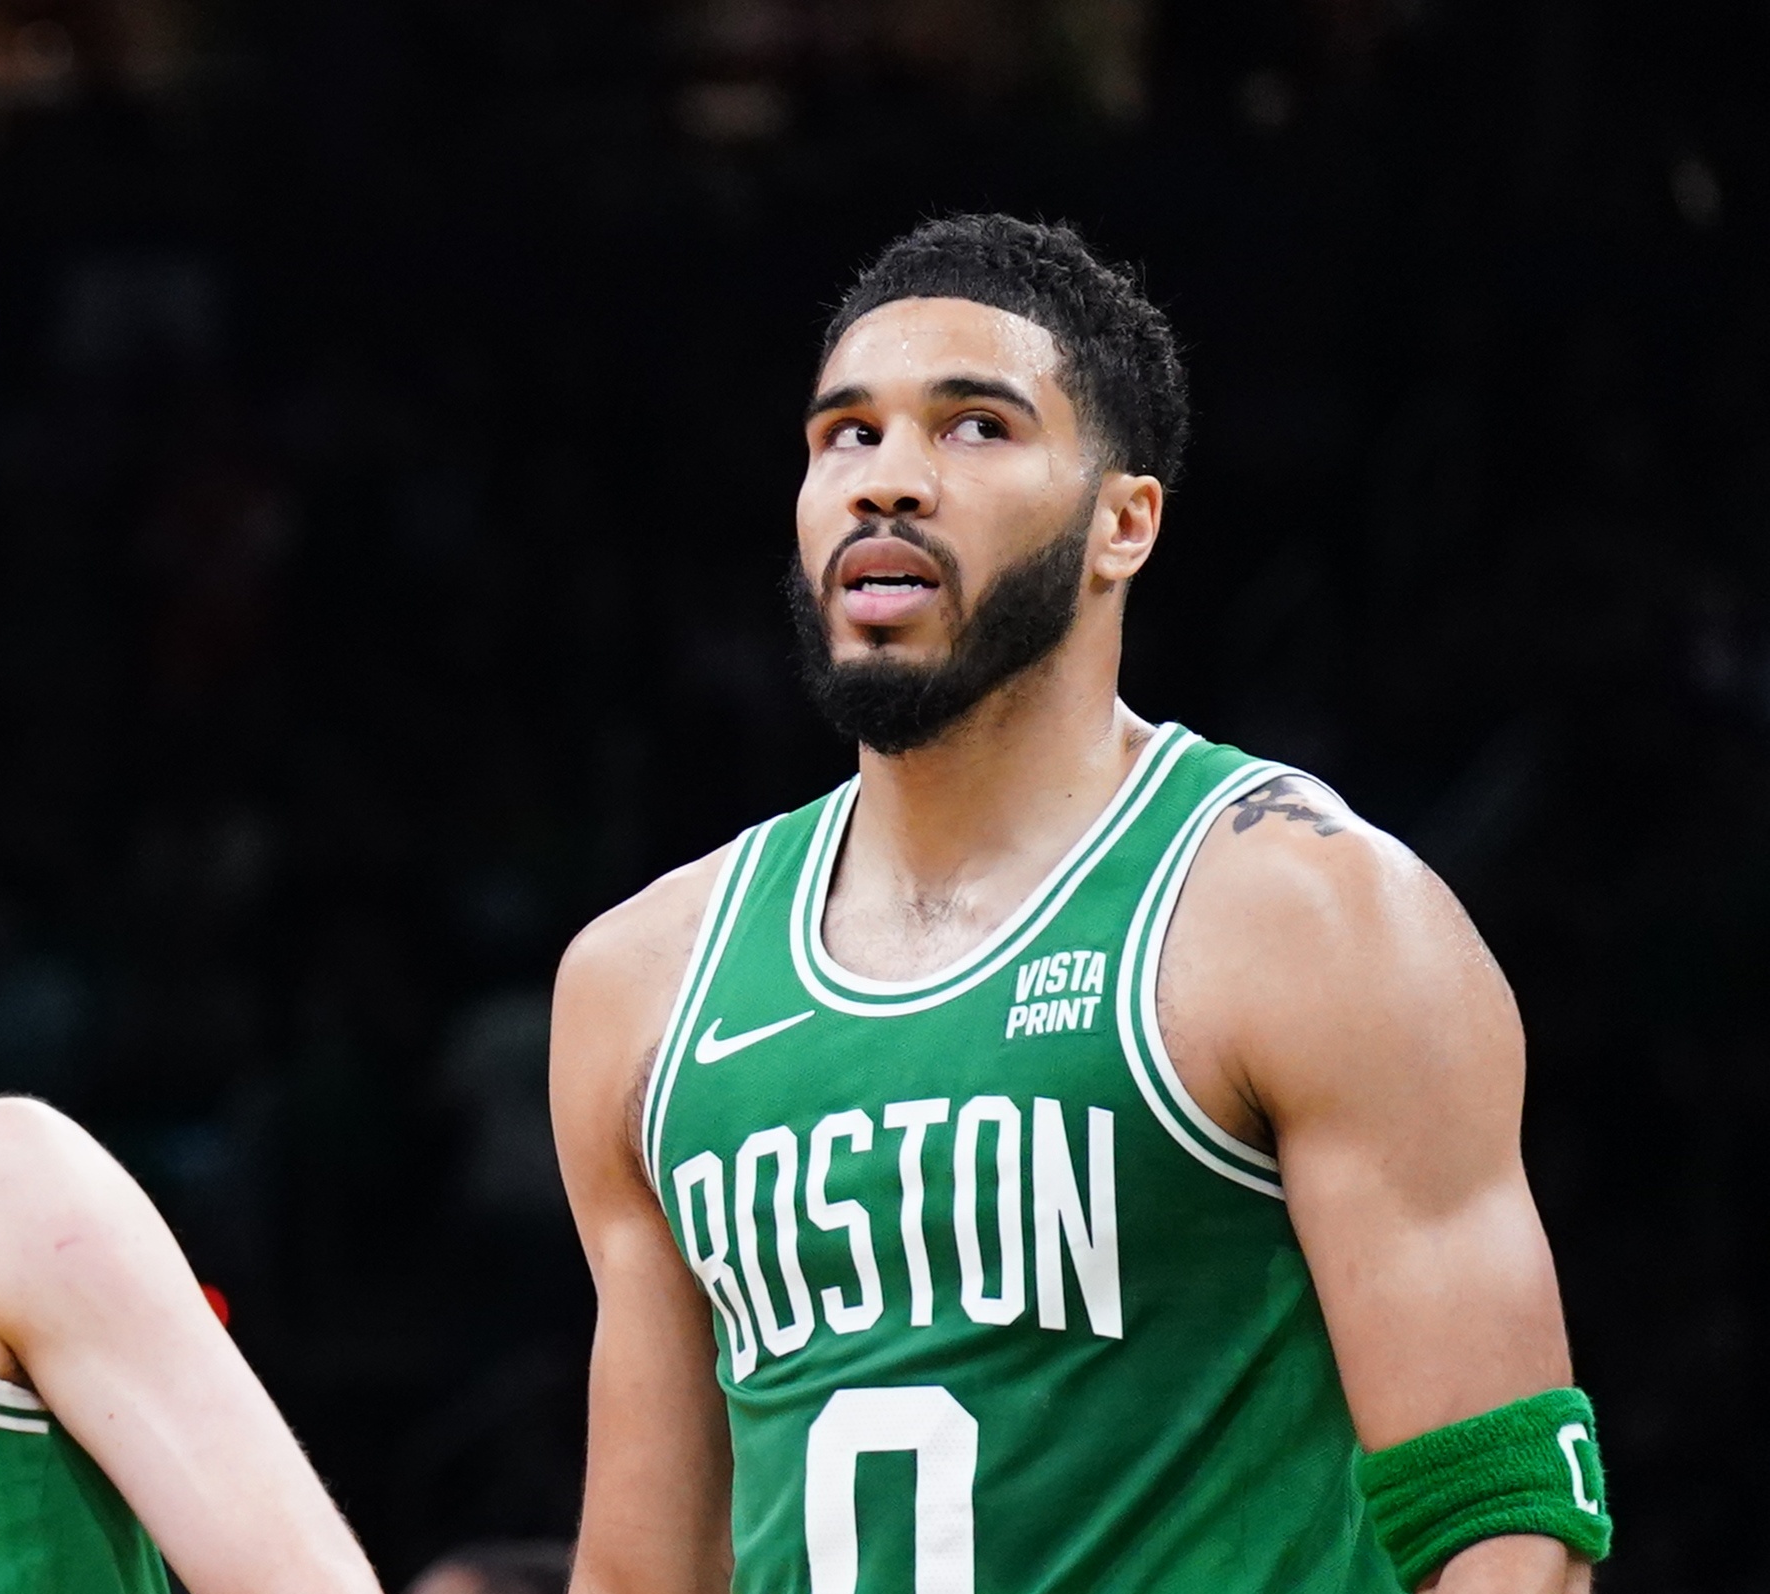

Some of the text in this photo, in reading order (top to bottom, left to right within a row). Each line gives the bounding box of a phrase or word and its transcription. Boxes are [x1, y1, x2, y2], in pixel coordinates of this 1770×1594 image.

[1016, 950, 1107, 1003] VISTA
[1005, 996, 1102, 1040] PRINT
[672, 1095, 1123, 1385] BOSTON
